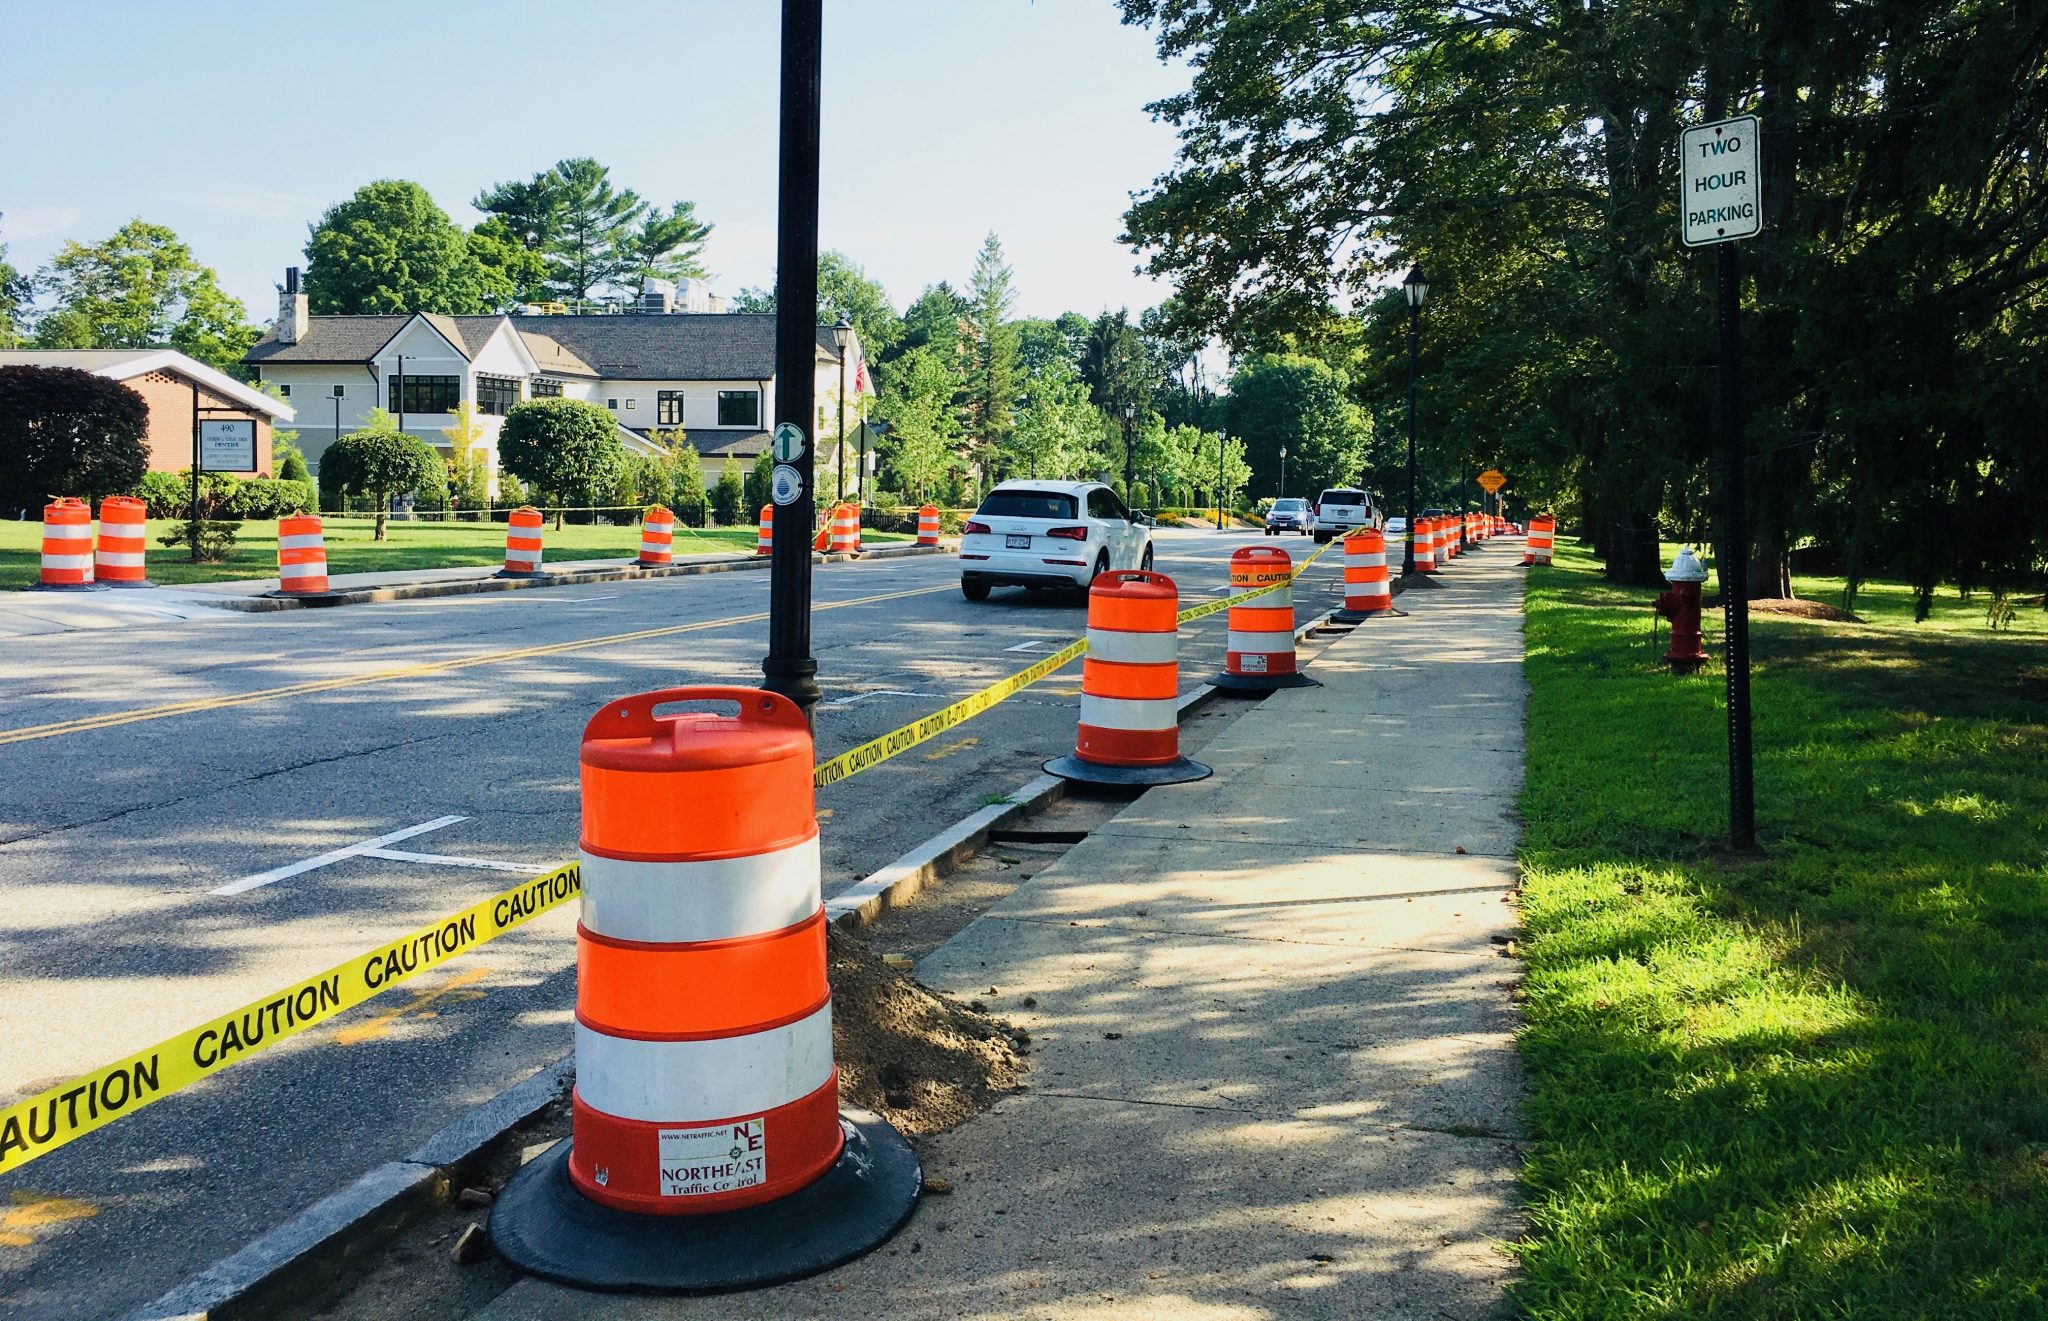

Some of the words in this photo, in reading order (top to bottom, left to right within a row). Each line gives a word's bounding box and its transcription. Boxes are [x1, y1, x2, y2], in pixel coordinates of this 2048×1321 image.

[1699, 137, 1741, 157] TWO
[1695, 170, 1746, 192] HOUR
[1689, 203, 1753, 227] PARKING
[220, 424, 235, 432] 490
[1230, 574, 1249, 583] TION
[1194, 605, 1212, 617] CAUTION
[849, 742, 882, 773] CAUTION
[886, 726, 915, 754] CAUTION
[919, 713, 944, 739] CAUTION
[192, 974, 341, 1069] CAUTION
[364, 913, 476, 989] CAUTION
[494, 866, 581, 928] CAUTION
[661, 1130, 728, 1140] WWW.NETRAFFIC.NET
[671, 1182, 709, 1195] Traffic
[713, 1173, 757, 1191] Cotrol
